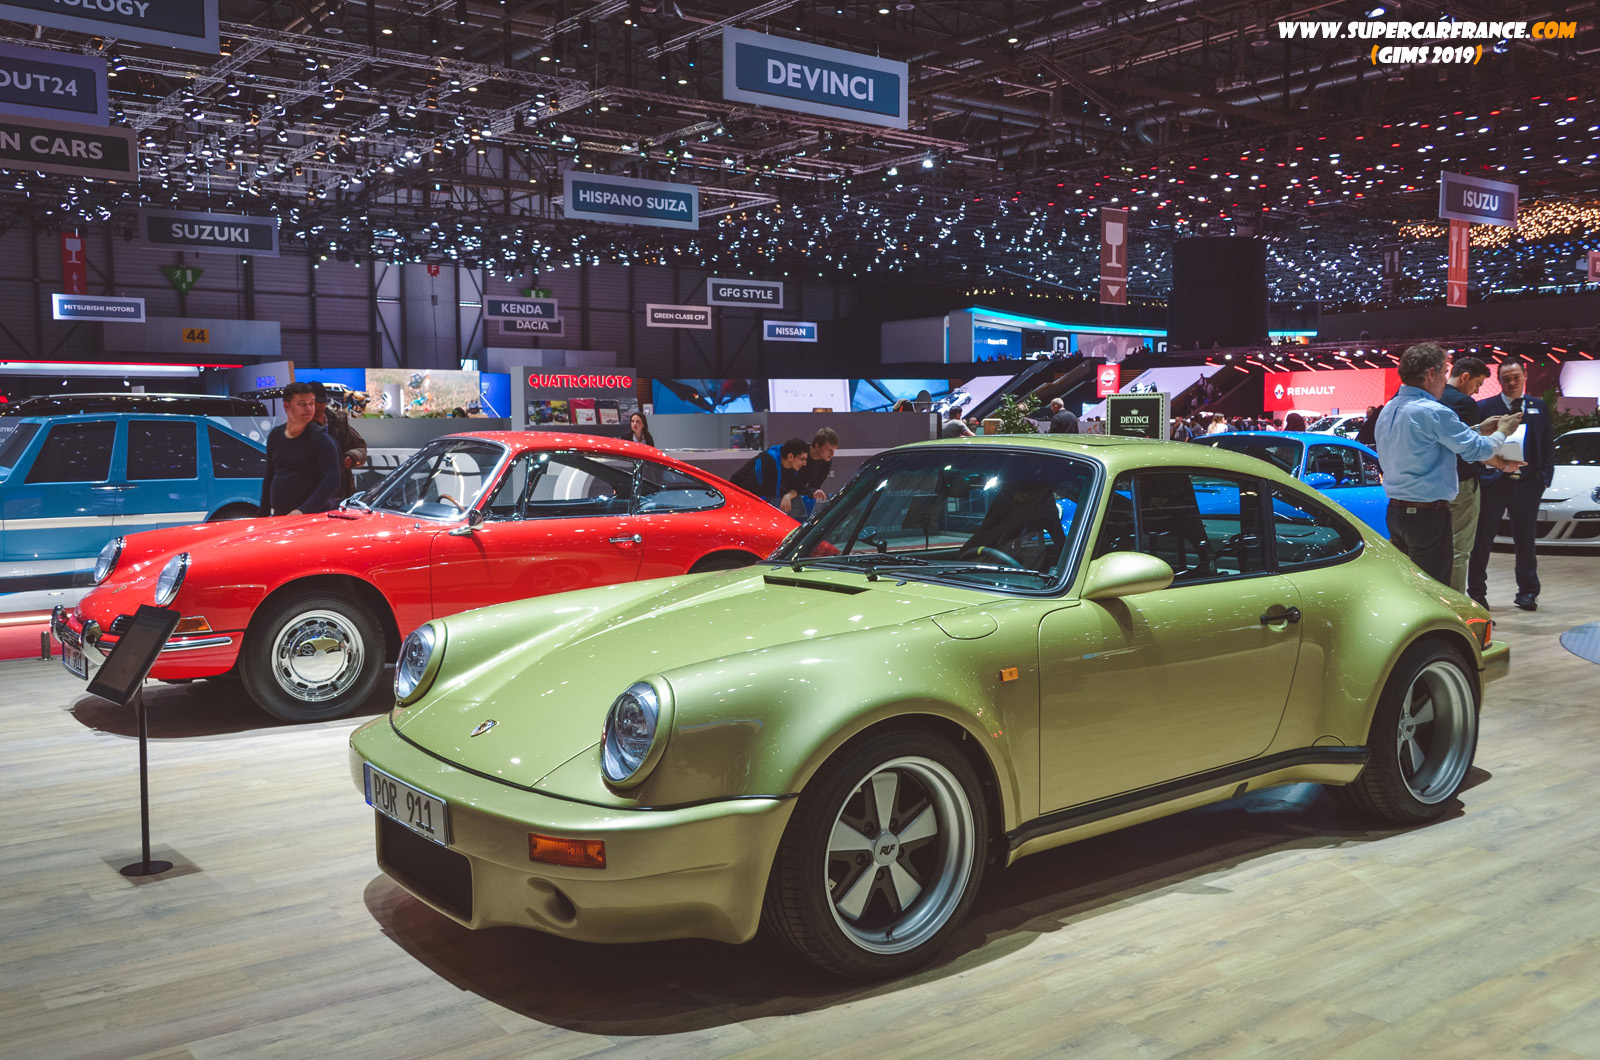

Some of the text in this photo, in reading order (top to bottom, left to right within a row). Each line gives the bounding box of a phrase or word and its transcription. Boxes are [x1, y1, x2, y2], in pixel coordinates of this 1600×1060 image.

[767, 58, 874, 102] DEVINCI
[30, 135, 103, 160] CARS
[579, 189, 687, 213] HISPANO SUIZA
[1463, 190, 1499, 212] ISUZU
[171, 223, 249, 243] SUZUKI
[719, 288, 773, 300] GFG STYLE
[64, 304, 104, 312] MITSUBISHI
[501, 303, 543, 315] KENDA
[654, 312, 674, 320] GREEN
[675, 313, 693, 321] CLASS
[516, 320, 549, 330] DACIA
[186, 330, 206, 342] 44
[776, 327, 806, 336] NISSAN
[1287, 386, 1335, 396] RENAULT
[1120, 416, 1149, 424] DEVINCI
[374, 773, 435, 835] POR 911
